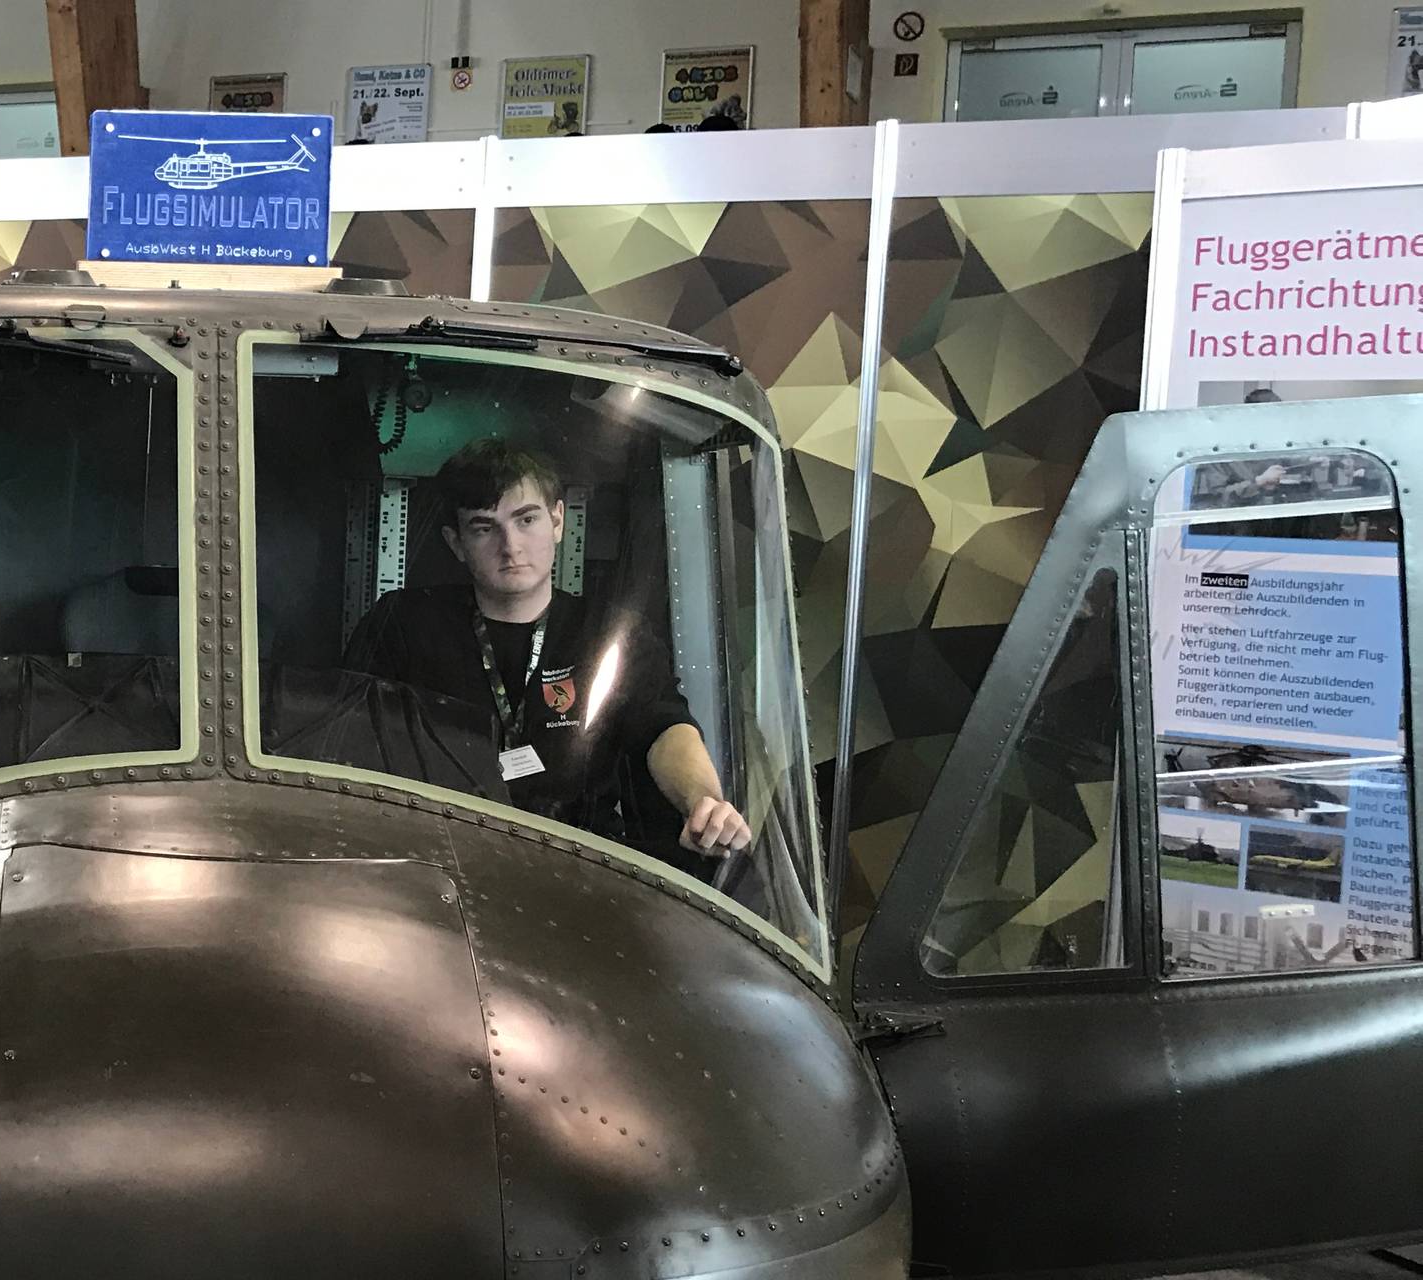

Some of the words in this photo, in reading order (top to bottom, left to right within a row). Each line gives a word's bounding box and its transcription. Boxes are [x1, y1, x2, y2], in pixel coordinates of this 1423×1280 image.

[394, 88, 424, 99] Sept.
[102, 185, 320, 230] FLUGSIMULATOR
[125, 243, 196, 255] AusbWkst
[202, 245, 210, 255] H
[216, 245, 292, 260] Bückeburg
[1191, 278, 1423, 313] Fachrichtun
[1185, 574, 1198, 584] Im
[1201, 575, 1248, 587] zweiten
[1250, 577, 1344, 592] Ausbildungsjahr
[1183, 589, 1231, 600] arbeiten
[1235, 591, 1253, 601] die
[1256, 592, 1349, 606] Auszubildenden
[1354, 597, 1365, 607] in
[1183, 603, 1230, 614] unserem
[1235, 605, 1291, 618] Lehrdock.
[1181, 623, 1203, 634] Hier
[1208, 626, 1246, 637] stehen
[1250, 627, 1333, 644] Luftfahrzeuge
[1337, 635, 1357, 644] zur
[1181, 637, 1240, 653] Verfügung,
[1245, 642, 1263, 652] die
[1267, 644, 1296, 655] nicht
[1301, 646, 1332, 657] mehr
[1336, 649, 1354, 659] am
[1358, 649, 1388, 663] Flug-
[1179, 651, 1220, 663] betrieb
[1224, 655, 1294, 669] teilnehmen.
[1178, 664, 1210, 677] Somit
[1214, 667, 1255, 680] können
[1259, 671, 1277, 682] die
[1280, 673, 1374, 689] Auszubildenden
[1176, 694, 1217, 707] prüfen,
[1222, 698, 1282, 711] reparieren
[1286, 703, 1308, 714] und
[1312, 706, 1354, 717] wieder
[1314, 691, 1375, 706] ausbauen,
[1175, 708, 1226, 720] einbauen
[1231, 713, 1251, 723] und
[1256, 715, 1317, 728] einstellen.
[1353, 837, 1382, 850] Dazu
[1347, 910, 1399, 926] Bauteile
